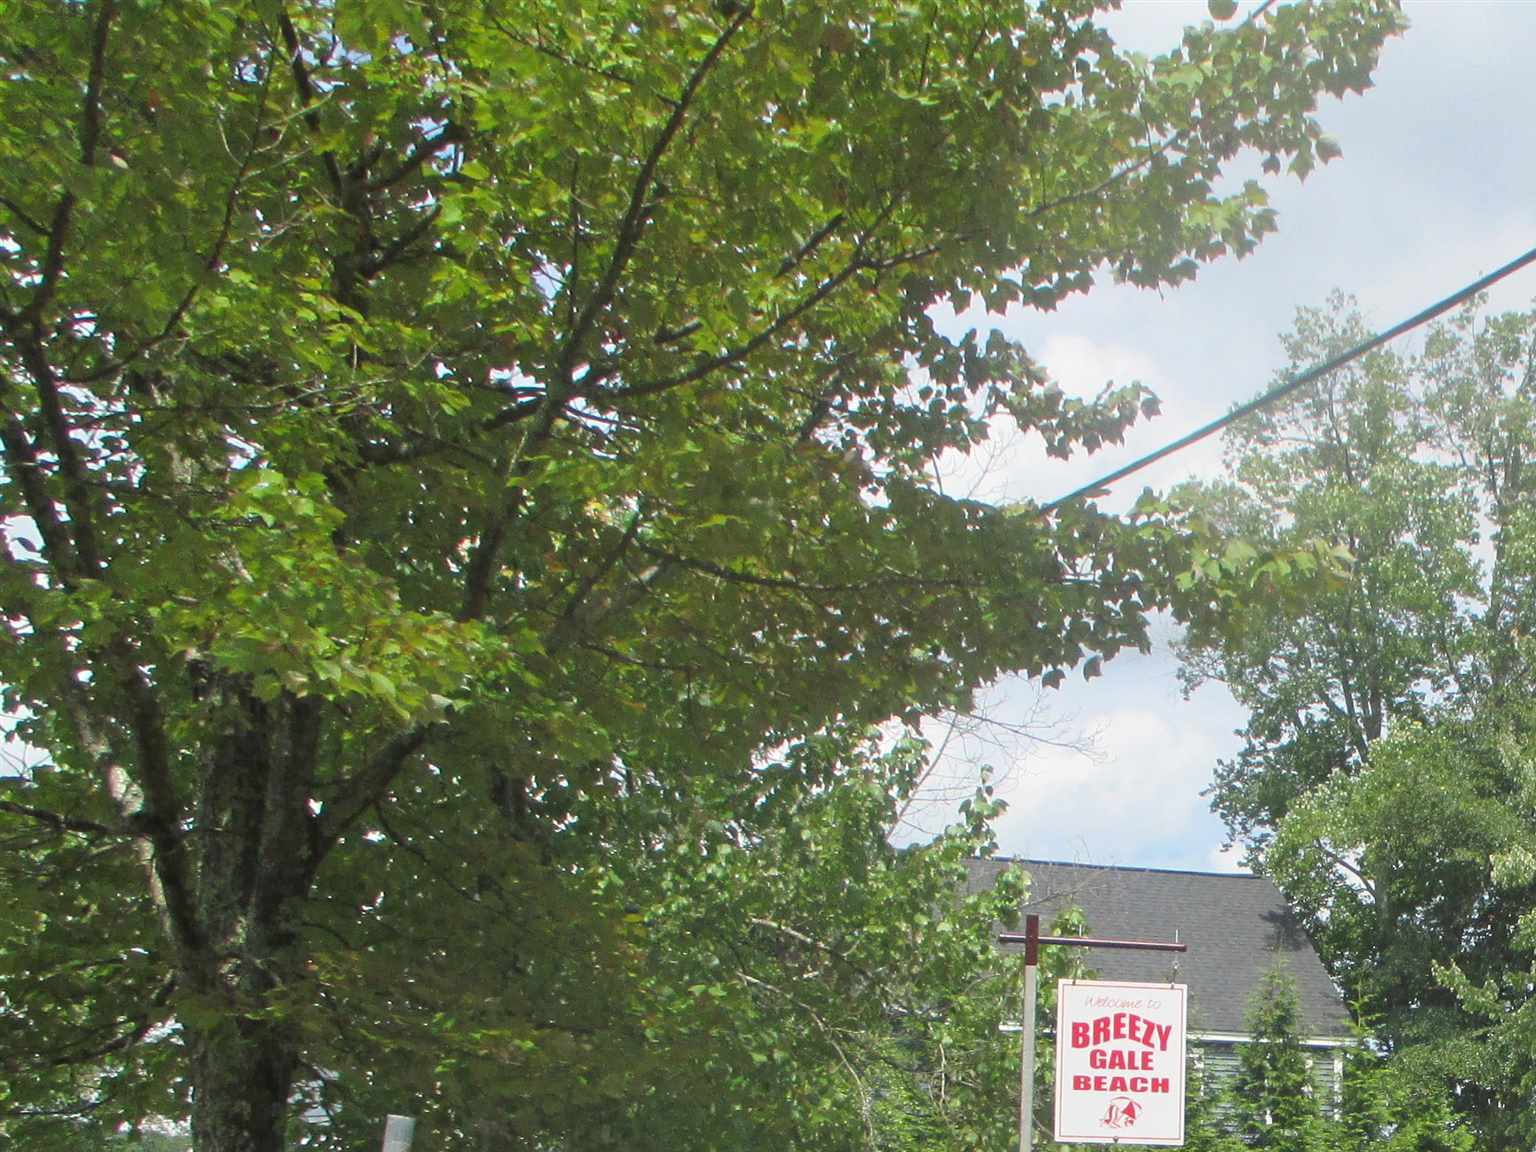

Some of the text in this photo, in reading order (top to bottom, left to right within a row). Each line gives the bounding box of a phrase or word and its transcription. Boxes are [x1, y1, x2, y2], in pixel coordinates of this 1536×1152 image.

[1071, 1012, 1172, 1051] BREEZY
[1089, 1049, 1154, 1071] GALE
[1072, 1075, 1169, 1093] BEACH
